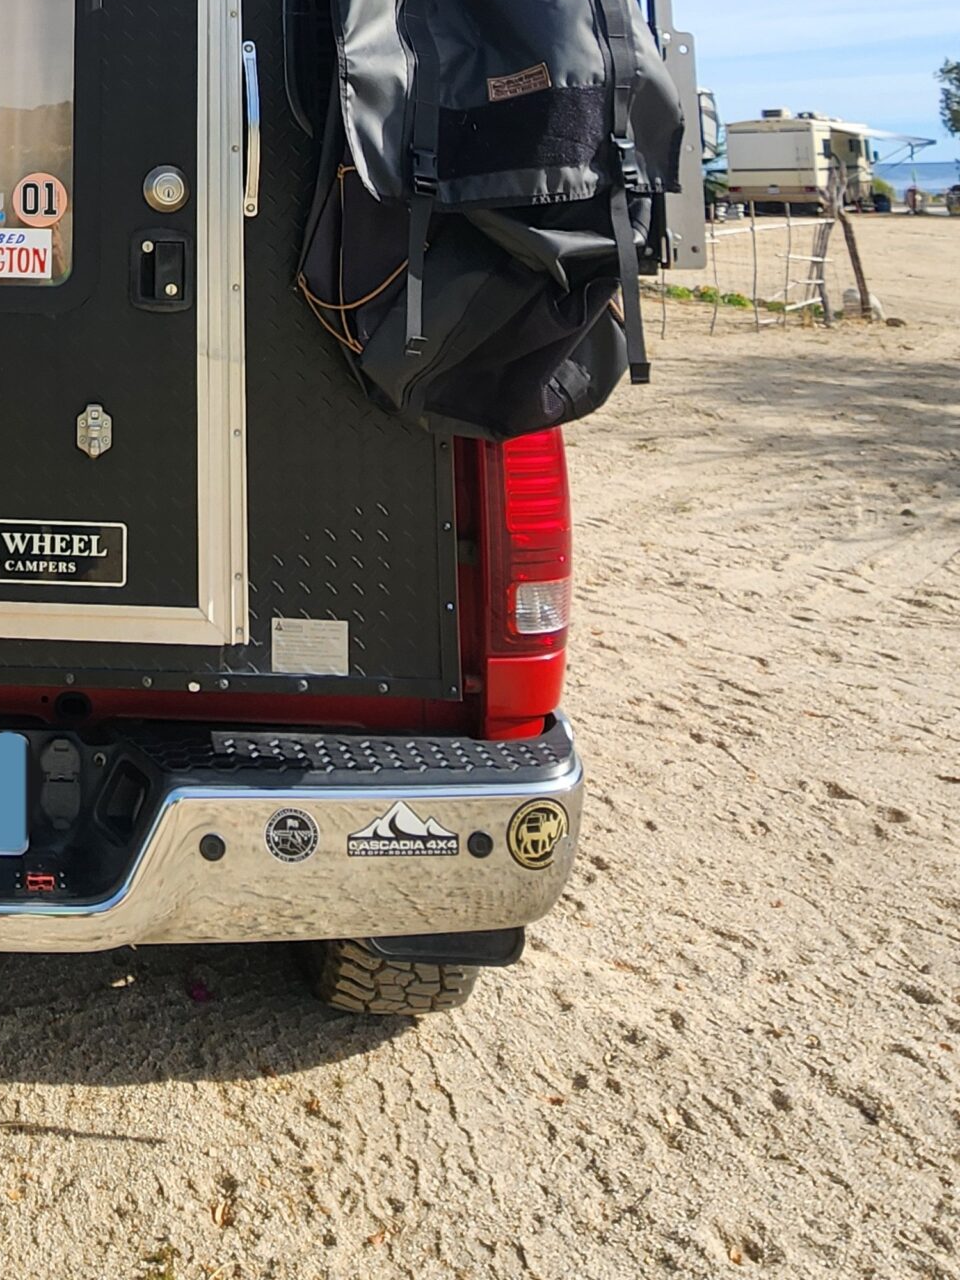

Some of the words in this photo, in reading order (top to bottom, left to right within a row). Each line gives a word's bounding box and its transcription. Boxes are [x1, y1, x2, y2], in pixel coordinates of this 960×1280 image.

[20, 181, 57, 216] 01
[1, 532, 108, 557] WHEEL
[4, 560, 76, 573] CAMPERS
